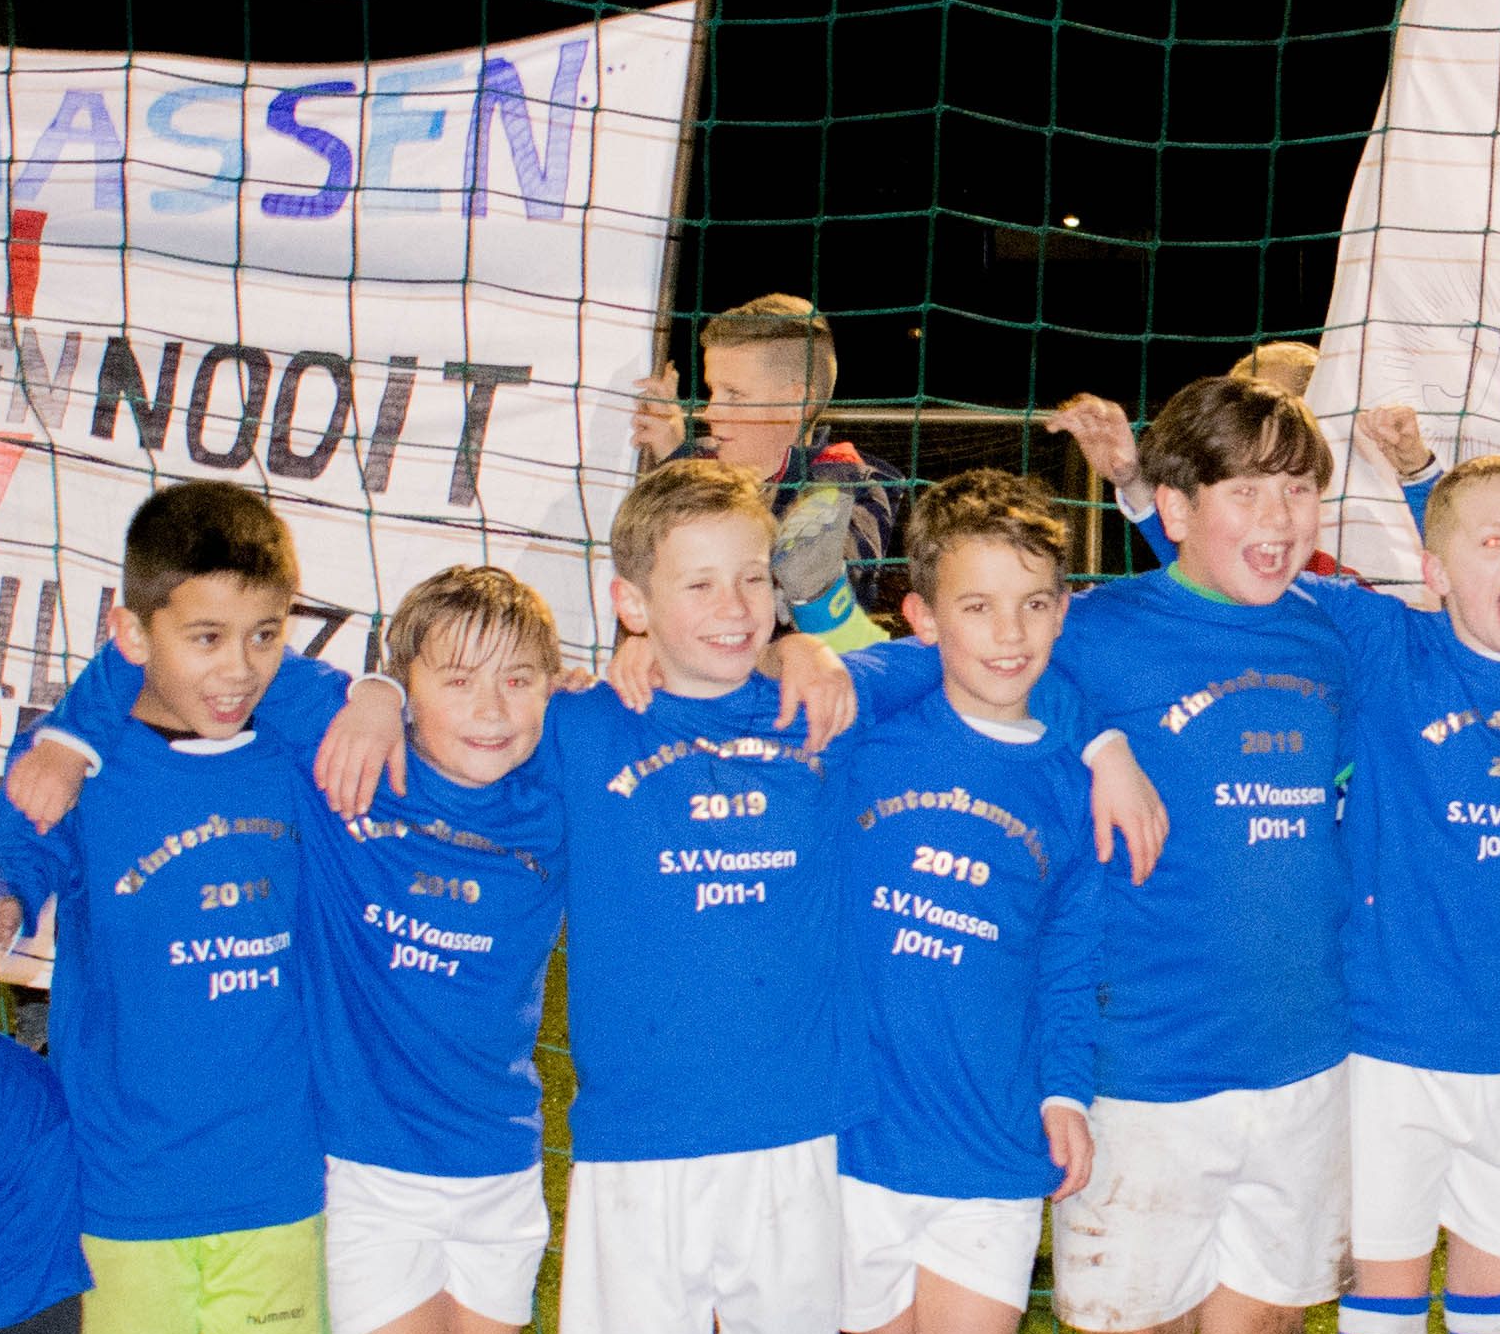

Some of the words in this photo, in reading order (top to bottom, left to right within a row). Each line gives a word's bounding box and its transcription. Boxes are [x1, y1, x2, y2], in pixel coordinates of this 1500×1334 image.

[91, 335, 532, 507] NOOIT
[690, 790, 768, 820] 2019
[1248, 817, 1306, 845] JO11-1
[912, 844, 991, 887] 2019
[200, 878, 272, 911] 2019
[408, 870, 482, 904] 2019
[695, 881, 766, 912] JO11-1
[389, 943, 460, 977] JO11-1
[892, 928, 964, 966] JO11-1
[209, 967, 281, 1001] JO11-1
